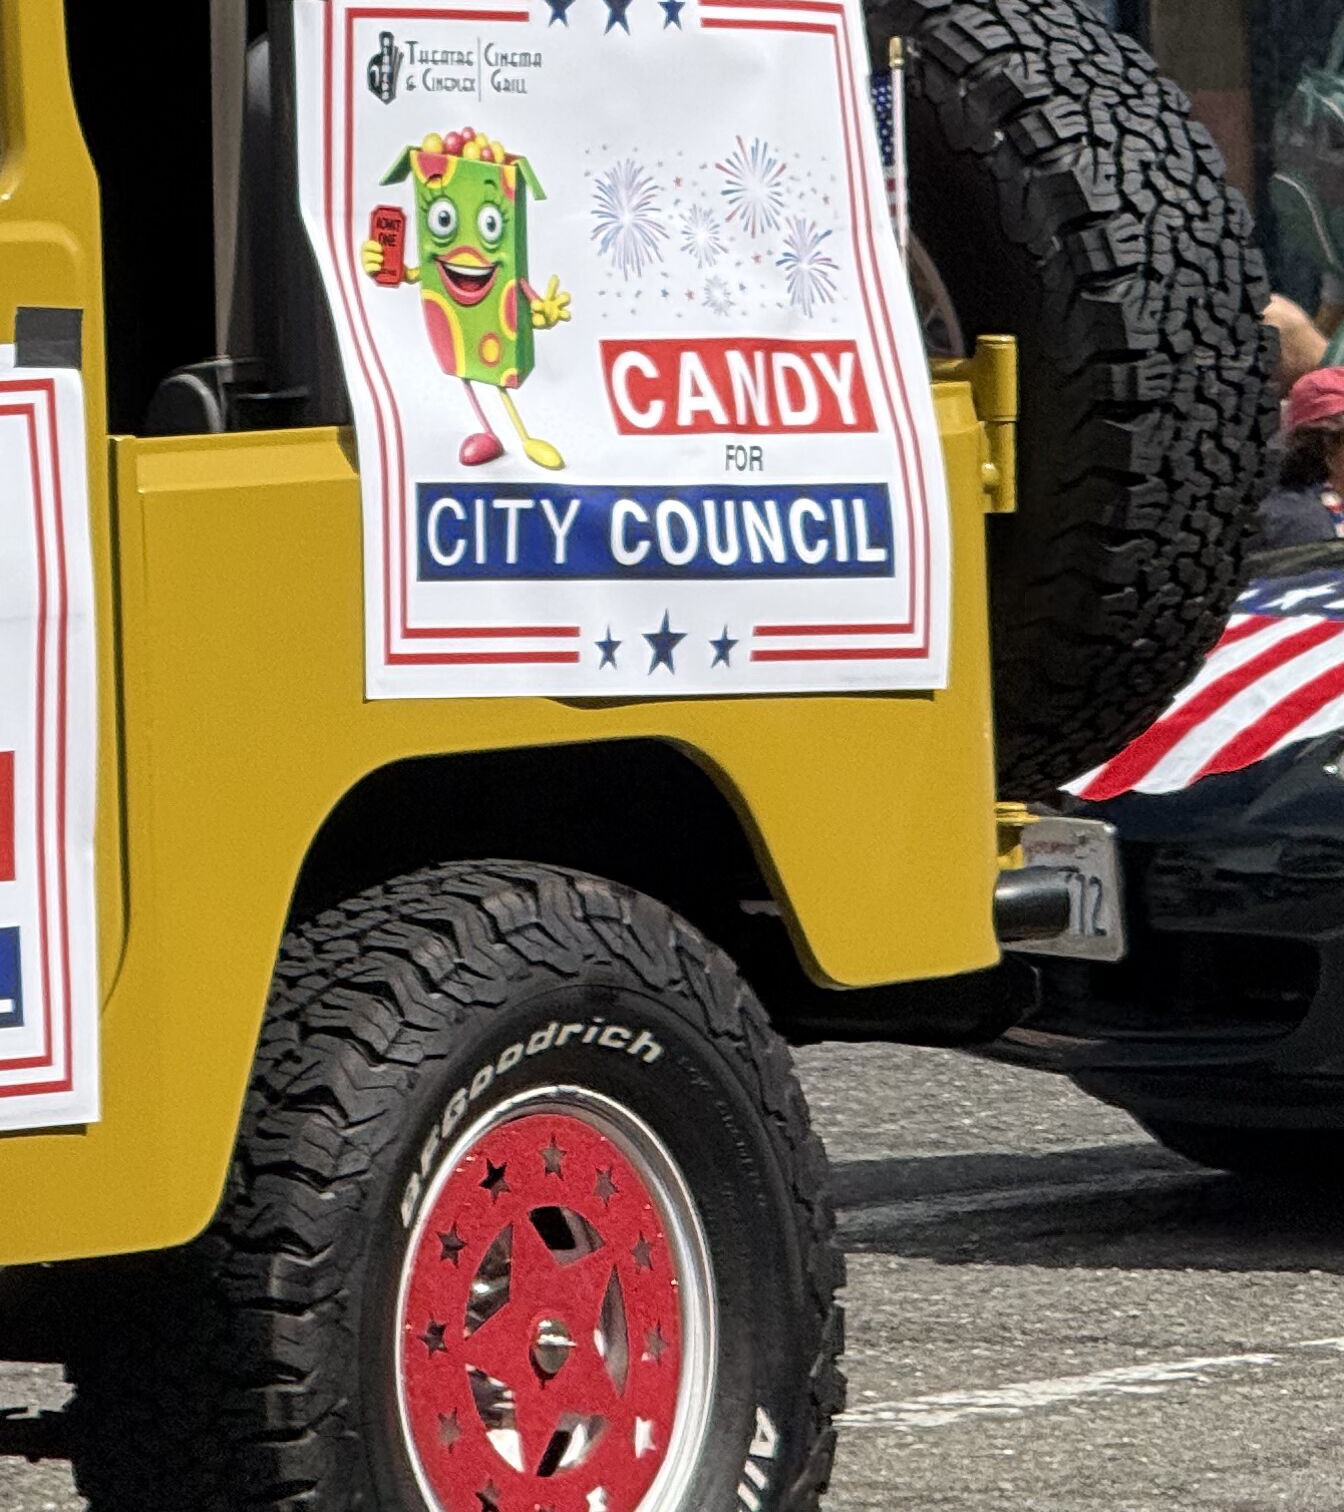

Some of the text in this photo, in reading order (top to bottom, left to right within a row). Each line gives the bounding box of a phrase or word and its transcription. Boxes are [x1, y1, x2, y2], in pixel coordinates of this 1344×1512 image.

[484, 42, 543, 68] CINEMA
[490, 68, 528, 94] GRILL
[614, 349, 856, 429] CANDY
[724, 444, 764, 472] FOR
[426, 497, 888, 567] CITY COUNCIL
